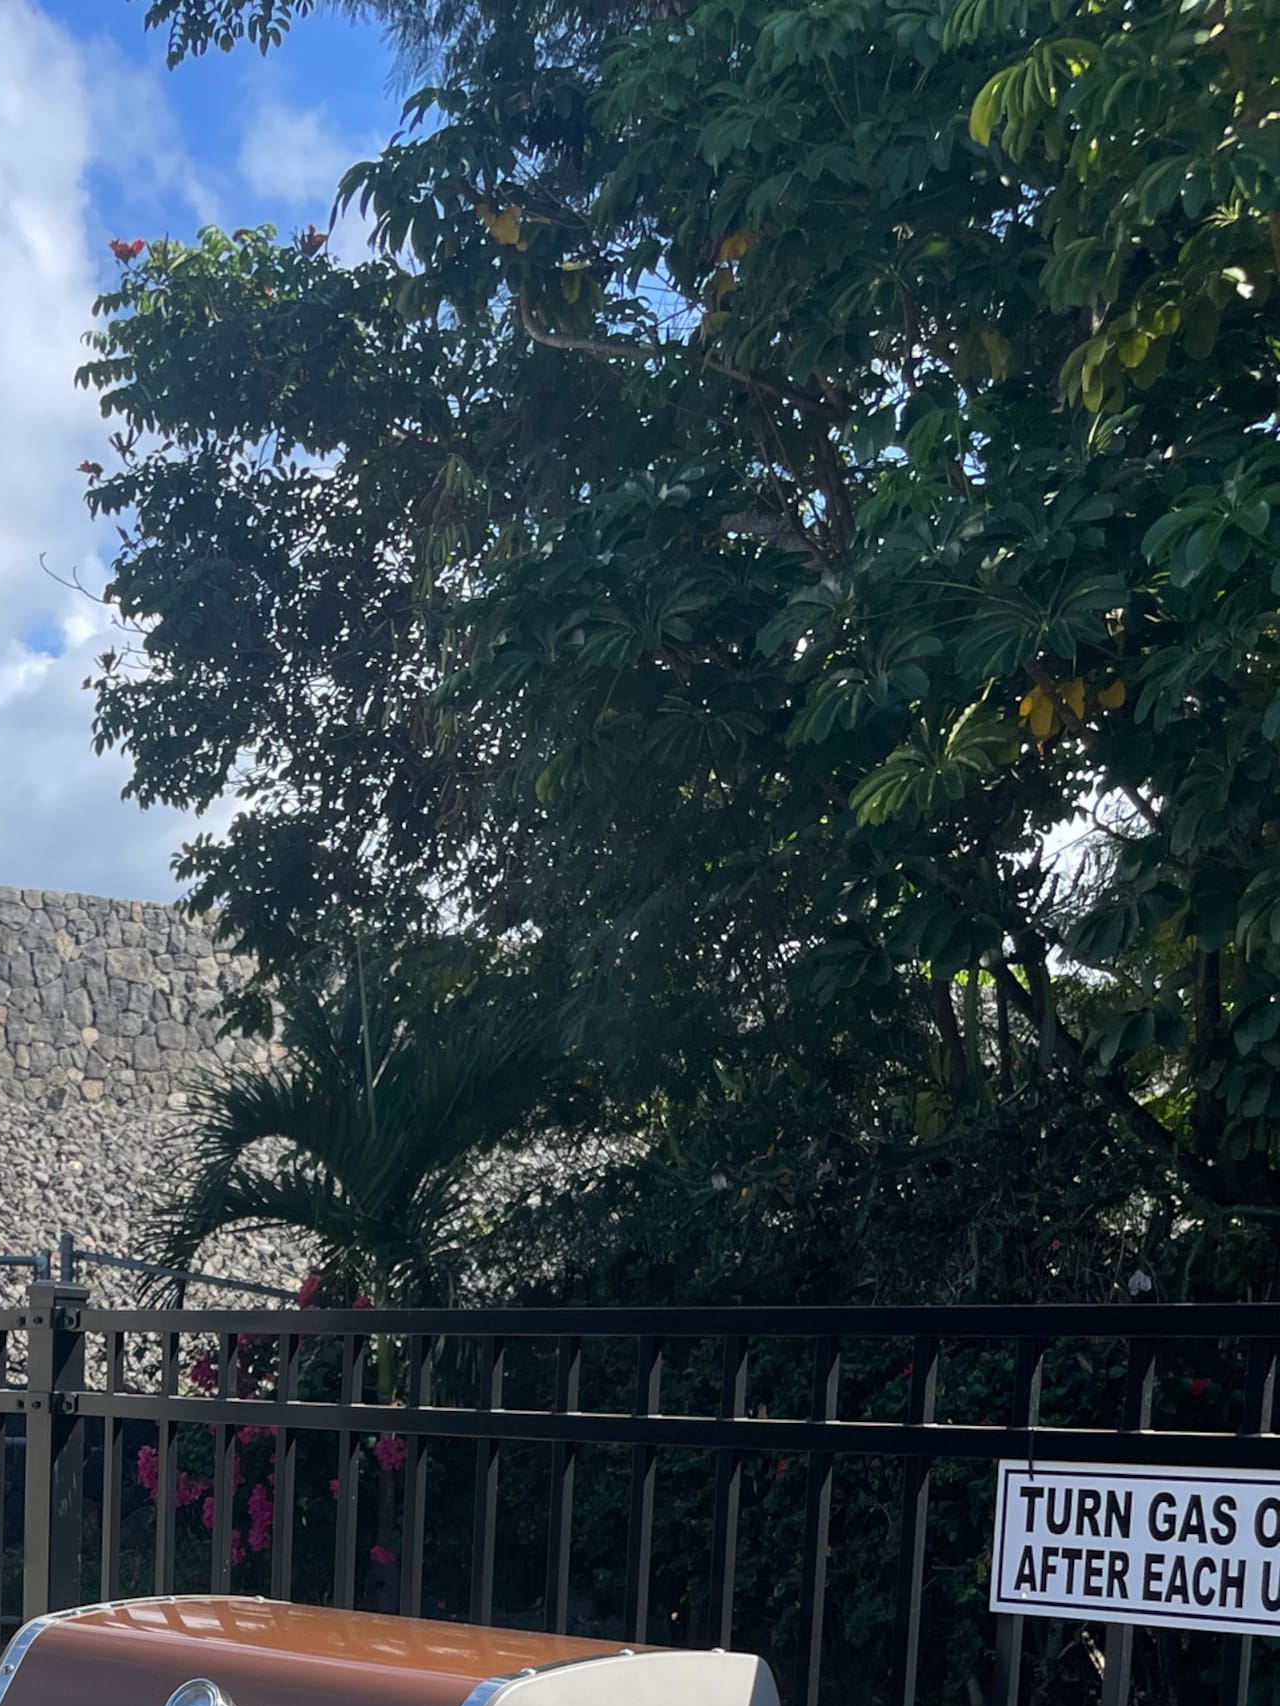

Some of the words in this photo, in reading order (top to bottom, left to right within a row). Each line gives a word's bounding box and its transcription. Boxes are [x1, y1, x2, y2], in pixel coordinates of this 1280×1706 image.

[1020, 1486, 1133, 1538] TURN
[1148, 1492, 1237, 1545] GAS
[1014, 1545, 1129, 1599] AFTER
[1142, 1553, 1246, 1608] EACH
